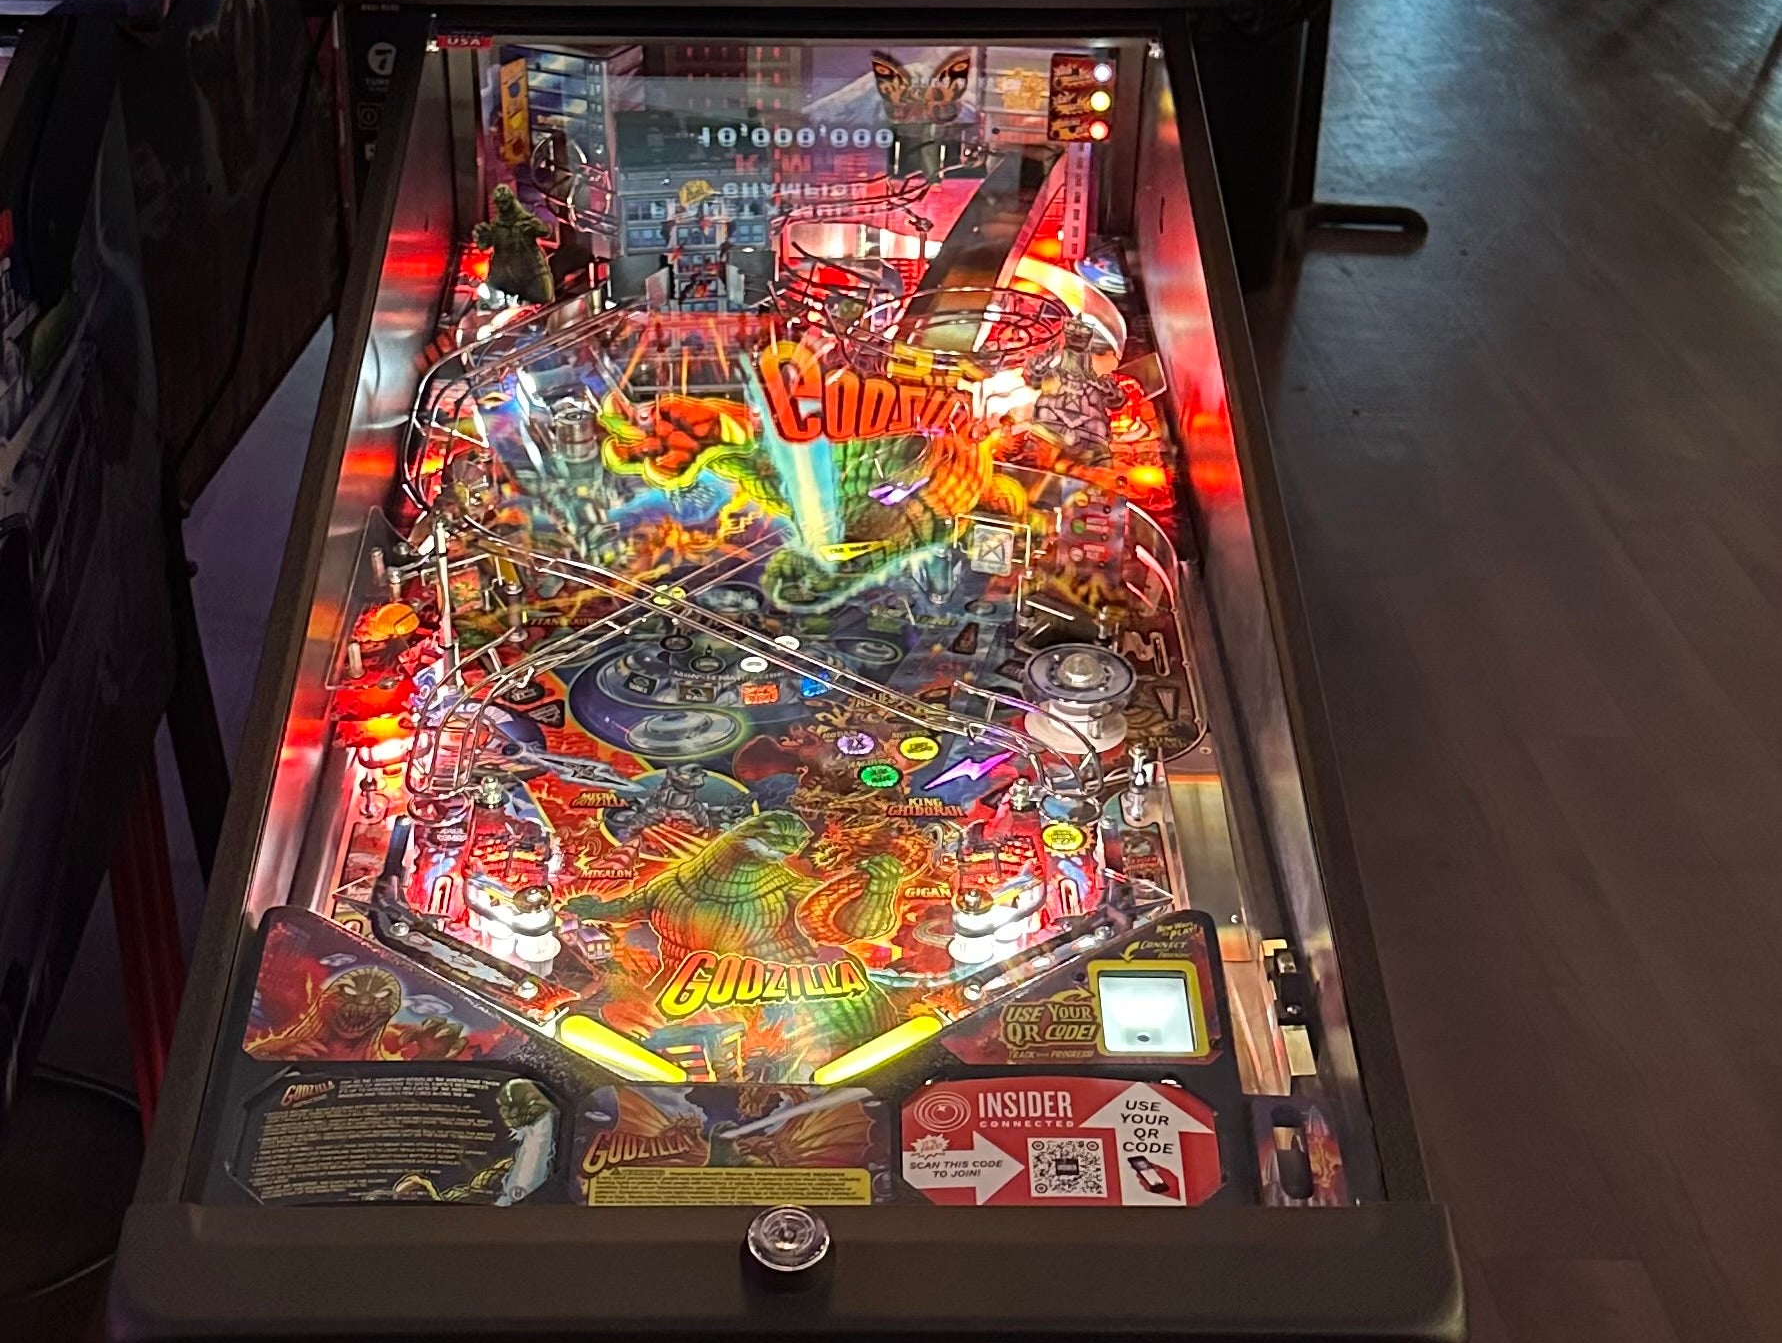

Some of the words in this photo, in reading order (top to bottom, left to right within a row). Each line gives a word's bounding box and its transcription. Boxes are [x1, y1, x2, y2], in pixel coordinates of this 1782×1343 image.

[447, 38, 481, 46] USA
[908, 798, 943, 806] KING
[888, 806, 965, 817] GHIDORAH
[905, 887, 951, 898] GIGAN
[661, 953, 867, 1016] GODZILLA
[1006, 1006, 1045, 1022] USE
[1047, 1003, 1093, 1022] YOUR
[1006, 1023, 1044, 1045] QR
[1045, 1024, 1096, 1040] CODE!
[281, 1081, 335, 1107] GODZILLA
[978, 1091, 1073, 1118] INSIDER
[1125, 1100, 1161, 1112] USE
[979, 1120, 1074, 1128] CONNECTED
[1121, 1113, 1169, 1126] YOUR
[1134, 1128, 1160, 1140] QR
[583, 1131, 695, 1173] GODZILLA
[1122, 1141, 1174, 1154] CODE
[910, 1161, 940, 1169] SCAN
[944, 1160, 969, 1168] THIS
[972, 1160, 1003, 1168] CODE
[933, 1170, 947, 1178] TO
[950, 1169, 981, 1178] JOIN!
